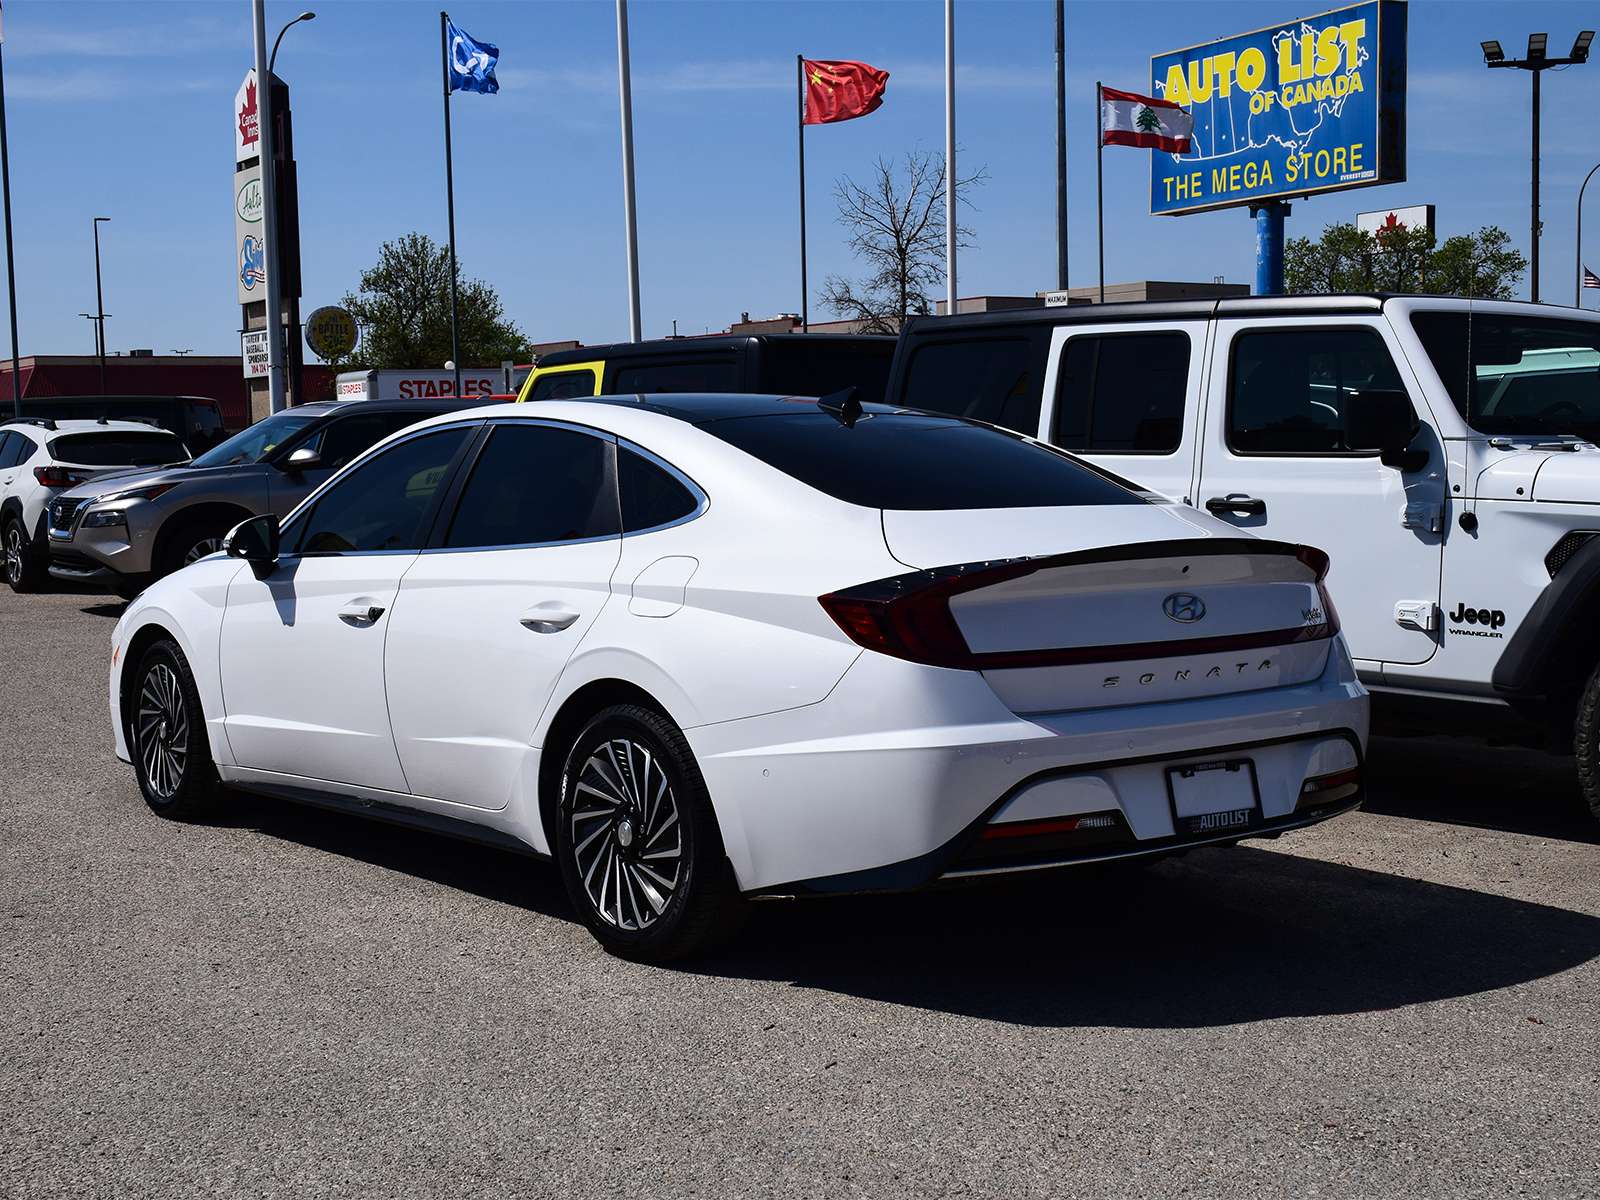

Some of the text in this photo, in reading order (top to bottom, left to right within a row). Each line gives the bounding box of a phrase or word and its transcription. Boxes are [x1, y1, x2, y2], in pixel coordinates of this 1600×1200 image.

[1164, 18, 1366, 107] AUTO LIST
[1249, 72, 1364, 115] OF CANADA
[1163, 143, 1364, 202] THE MEGA STORE
[342, 384, 362, 394] STAPLES
[1449, 602, 1506, 630] Jeep
[1449, 628, 1503, 638] WRANGLER
[1102, 658, 1272, 688] SONATA
